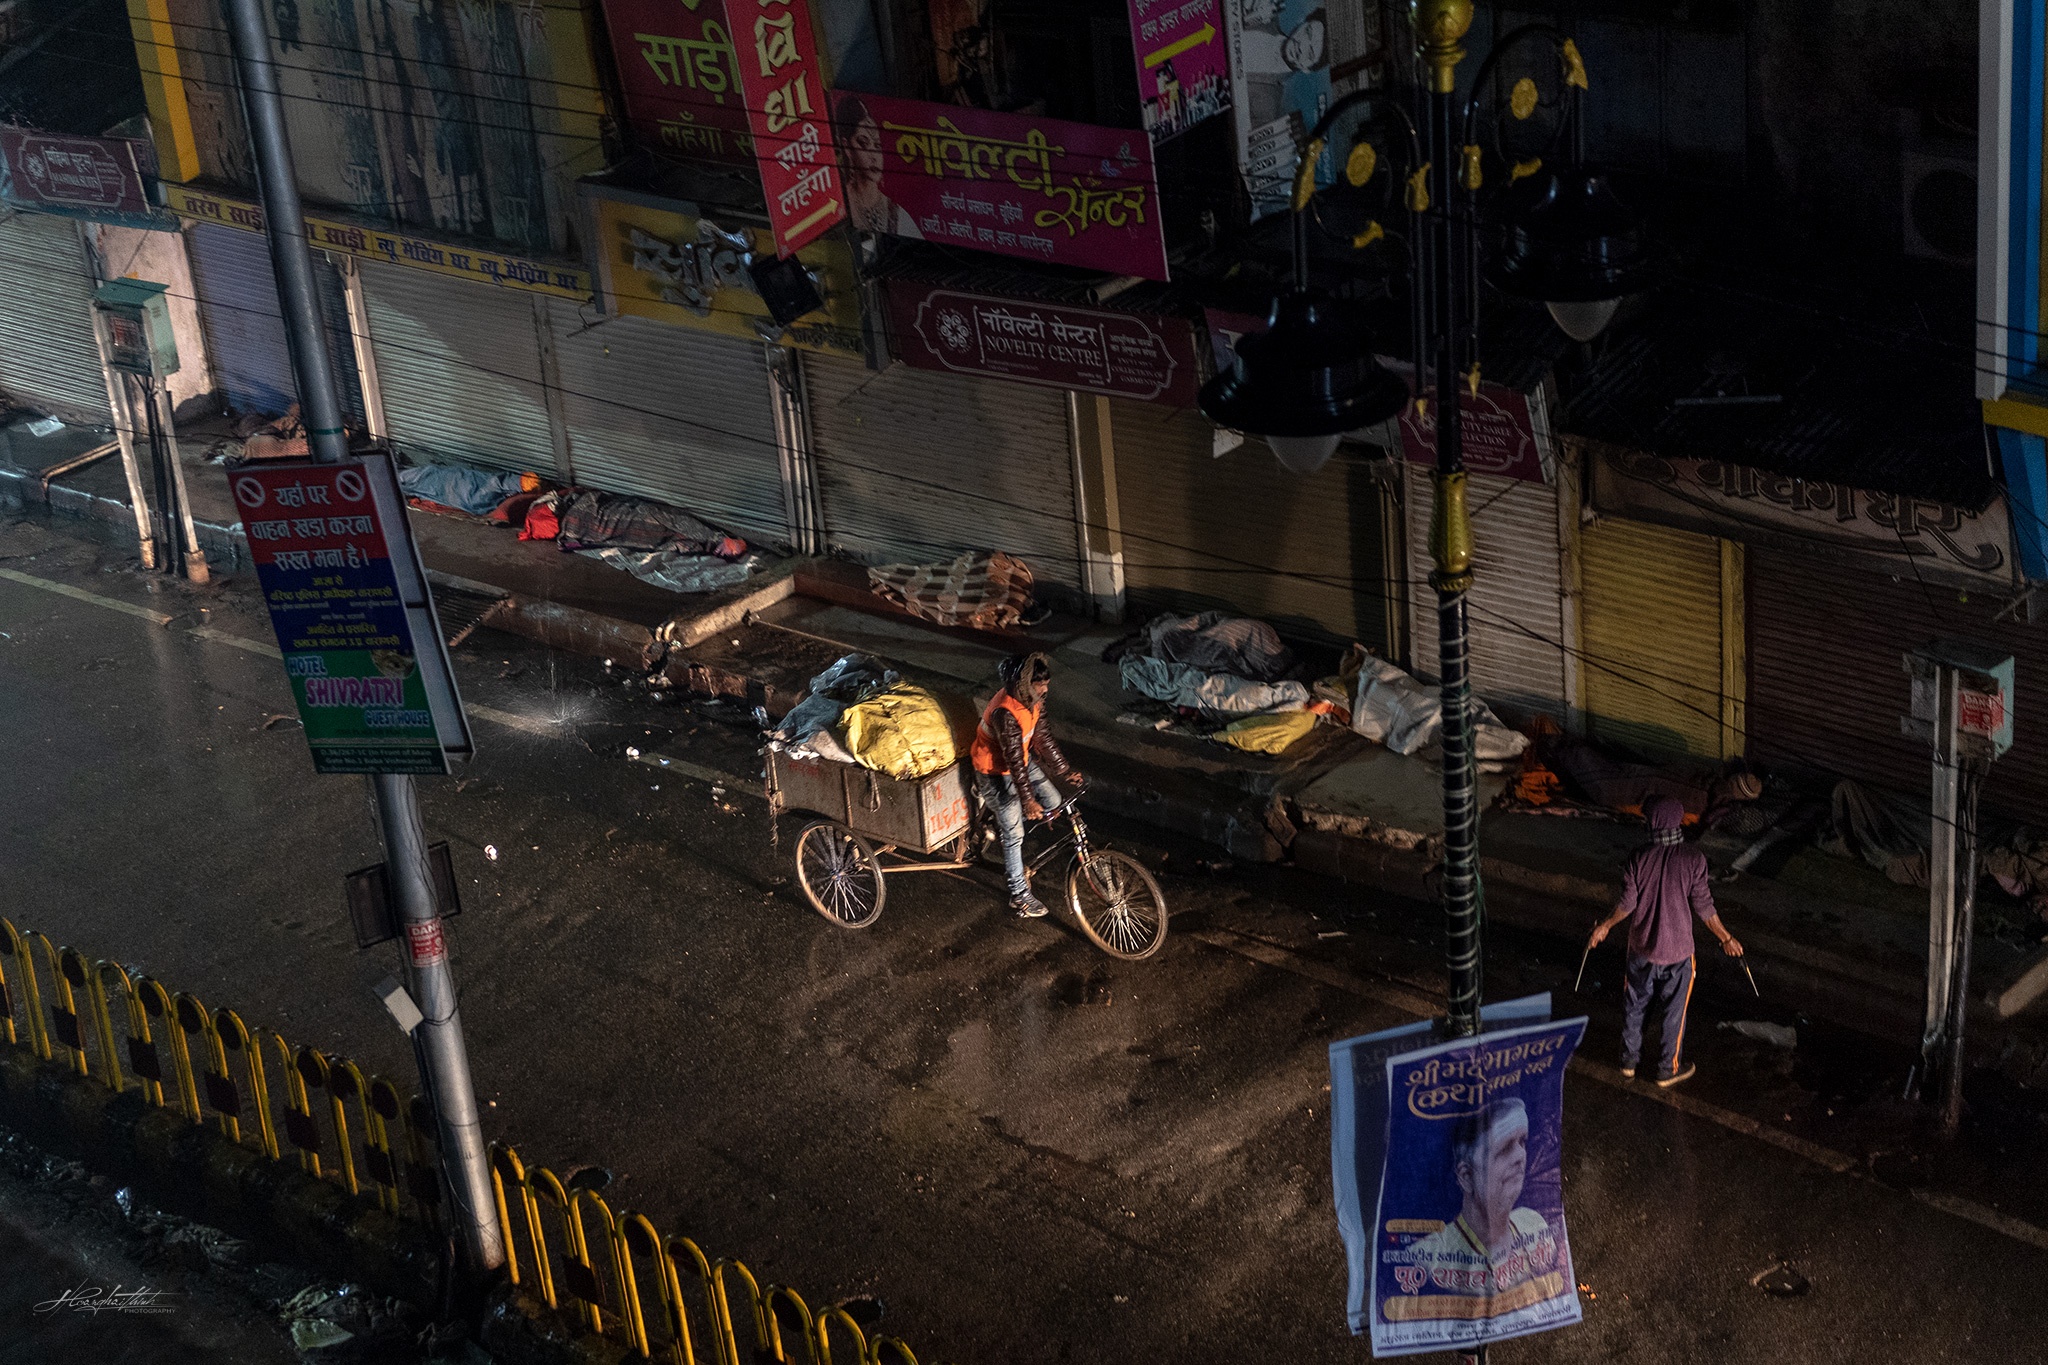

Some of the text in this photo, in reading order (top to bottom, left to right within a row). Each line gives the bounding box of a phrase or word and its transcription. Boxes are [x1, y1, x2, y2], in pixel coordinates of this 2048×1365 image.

[775, 122, 821, 172] साड़ी
[182, 195, 221, 219] तरंग
[979, 307, 1099, 347] नॉवेल्टी सेन्टर
[984, 334, 1103, 367] NOVELTY CENTRE
[306, 484, 331, 505] पर
[250, 519, 291, 541] वाहन
[327, 515, 374, 536] करना
[313, 547, 345, 569] मना
[288, 655, 328, 676] HOTEL
[305, 676, 405, 707] SHIVRATRI
[364, 710, 430, 727] GUEST HOUSE
